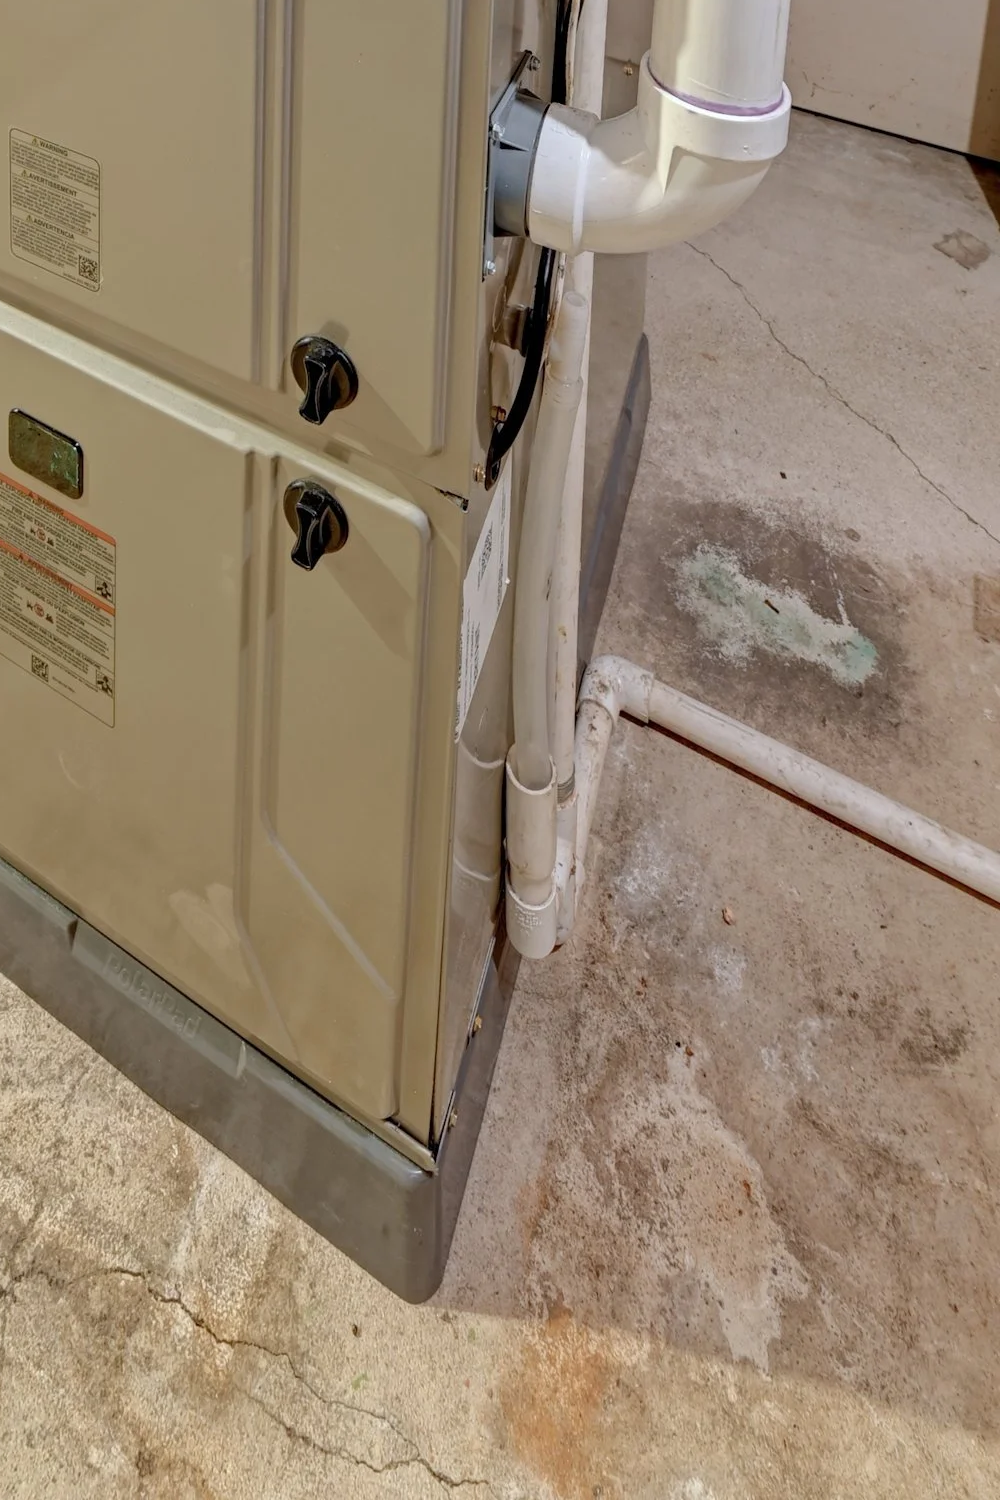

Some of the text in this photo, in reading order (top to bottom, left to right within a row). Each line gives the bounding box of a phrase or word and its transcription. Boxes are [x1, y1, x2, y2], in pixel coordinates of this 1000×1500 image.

[40, 141, 68, 156] WARNING
[29, 173, 77, 197] AVERTISSEMENT
[34, 218, 75, 239] ADVERTENCIA
